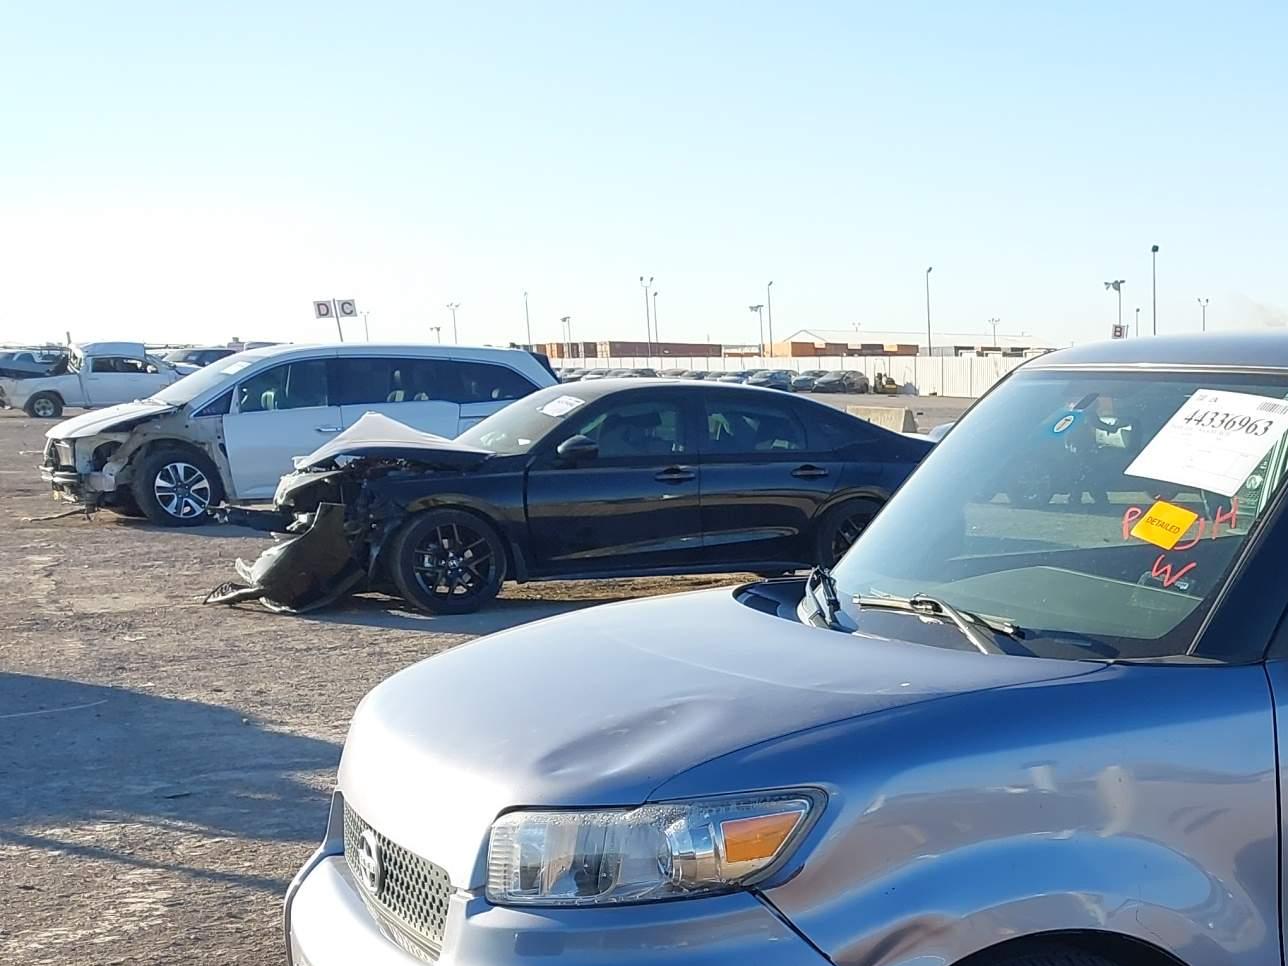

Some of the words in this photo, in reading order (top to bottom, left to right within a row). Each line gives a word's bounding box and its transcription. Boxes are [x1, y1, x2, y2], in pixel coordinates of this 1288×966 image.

[316, 302, 330, 317] D
[341, 301, 354, 315] C
[1184, 408, 1274, 437] 44336963
[1145, 515, 1181, 535] DETAILED
